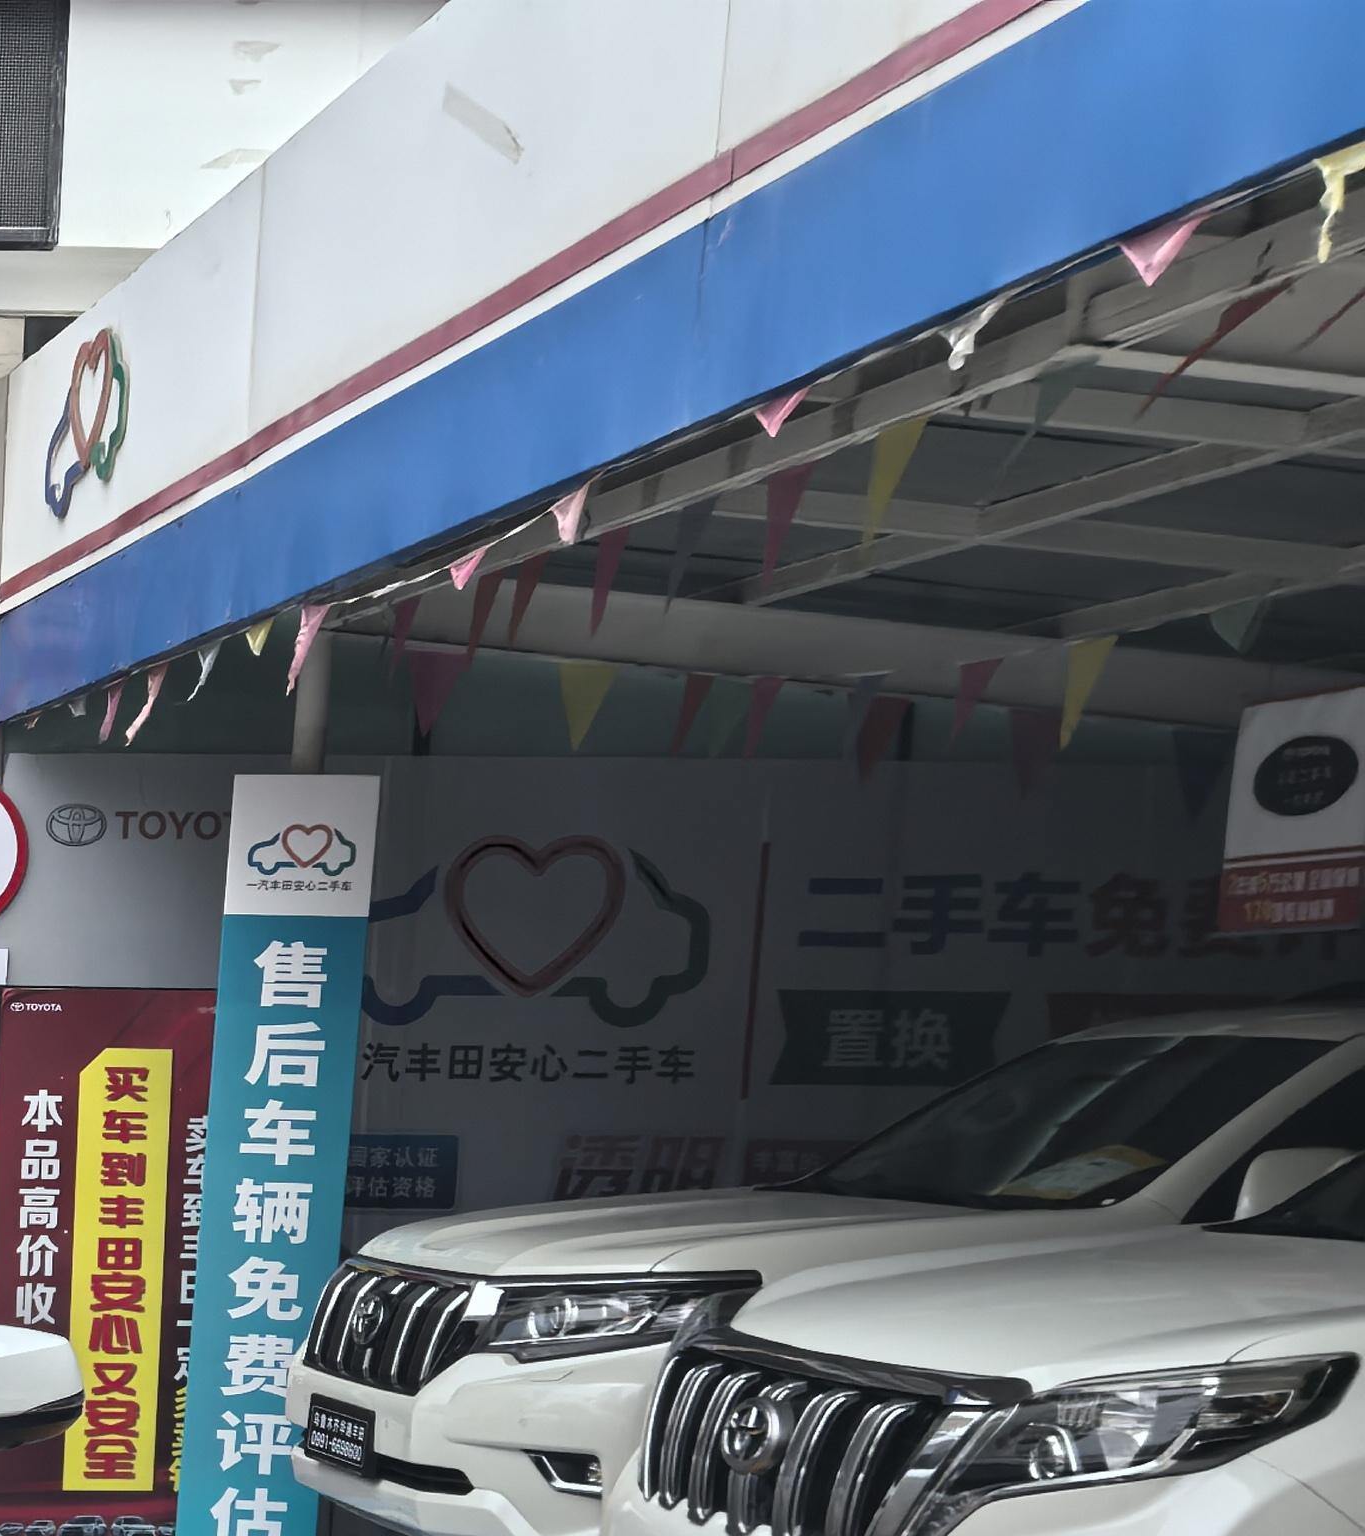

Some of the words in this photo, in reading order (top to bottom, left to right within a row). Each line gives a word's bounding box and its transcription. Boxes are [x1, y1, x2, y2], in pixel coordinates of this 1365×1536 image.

[115, 811, 231, 840] TOYO
[25, 1003, 62, 1011] TOYOTA
[822, 1008, 955, 1071] 置换
[83, 1066, 150, 1481] 买车到丰田安心又安全
